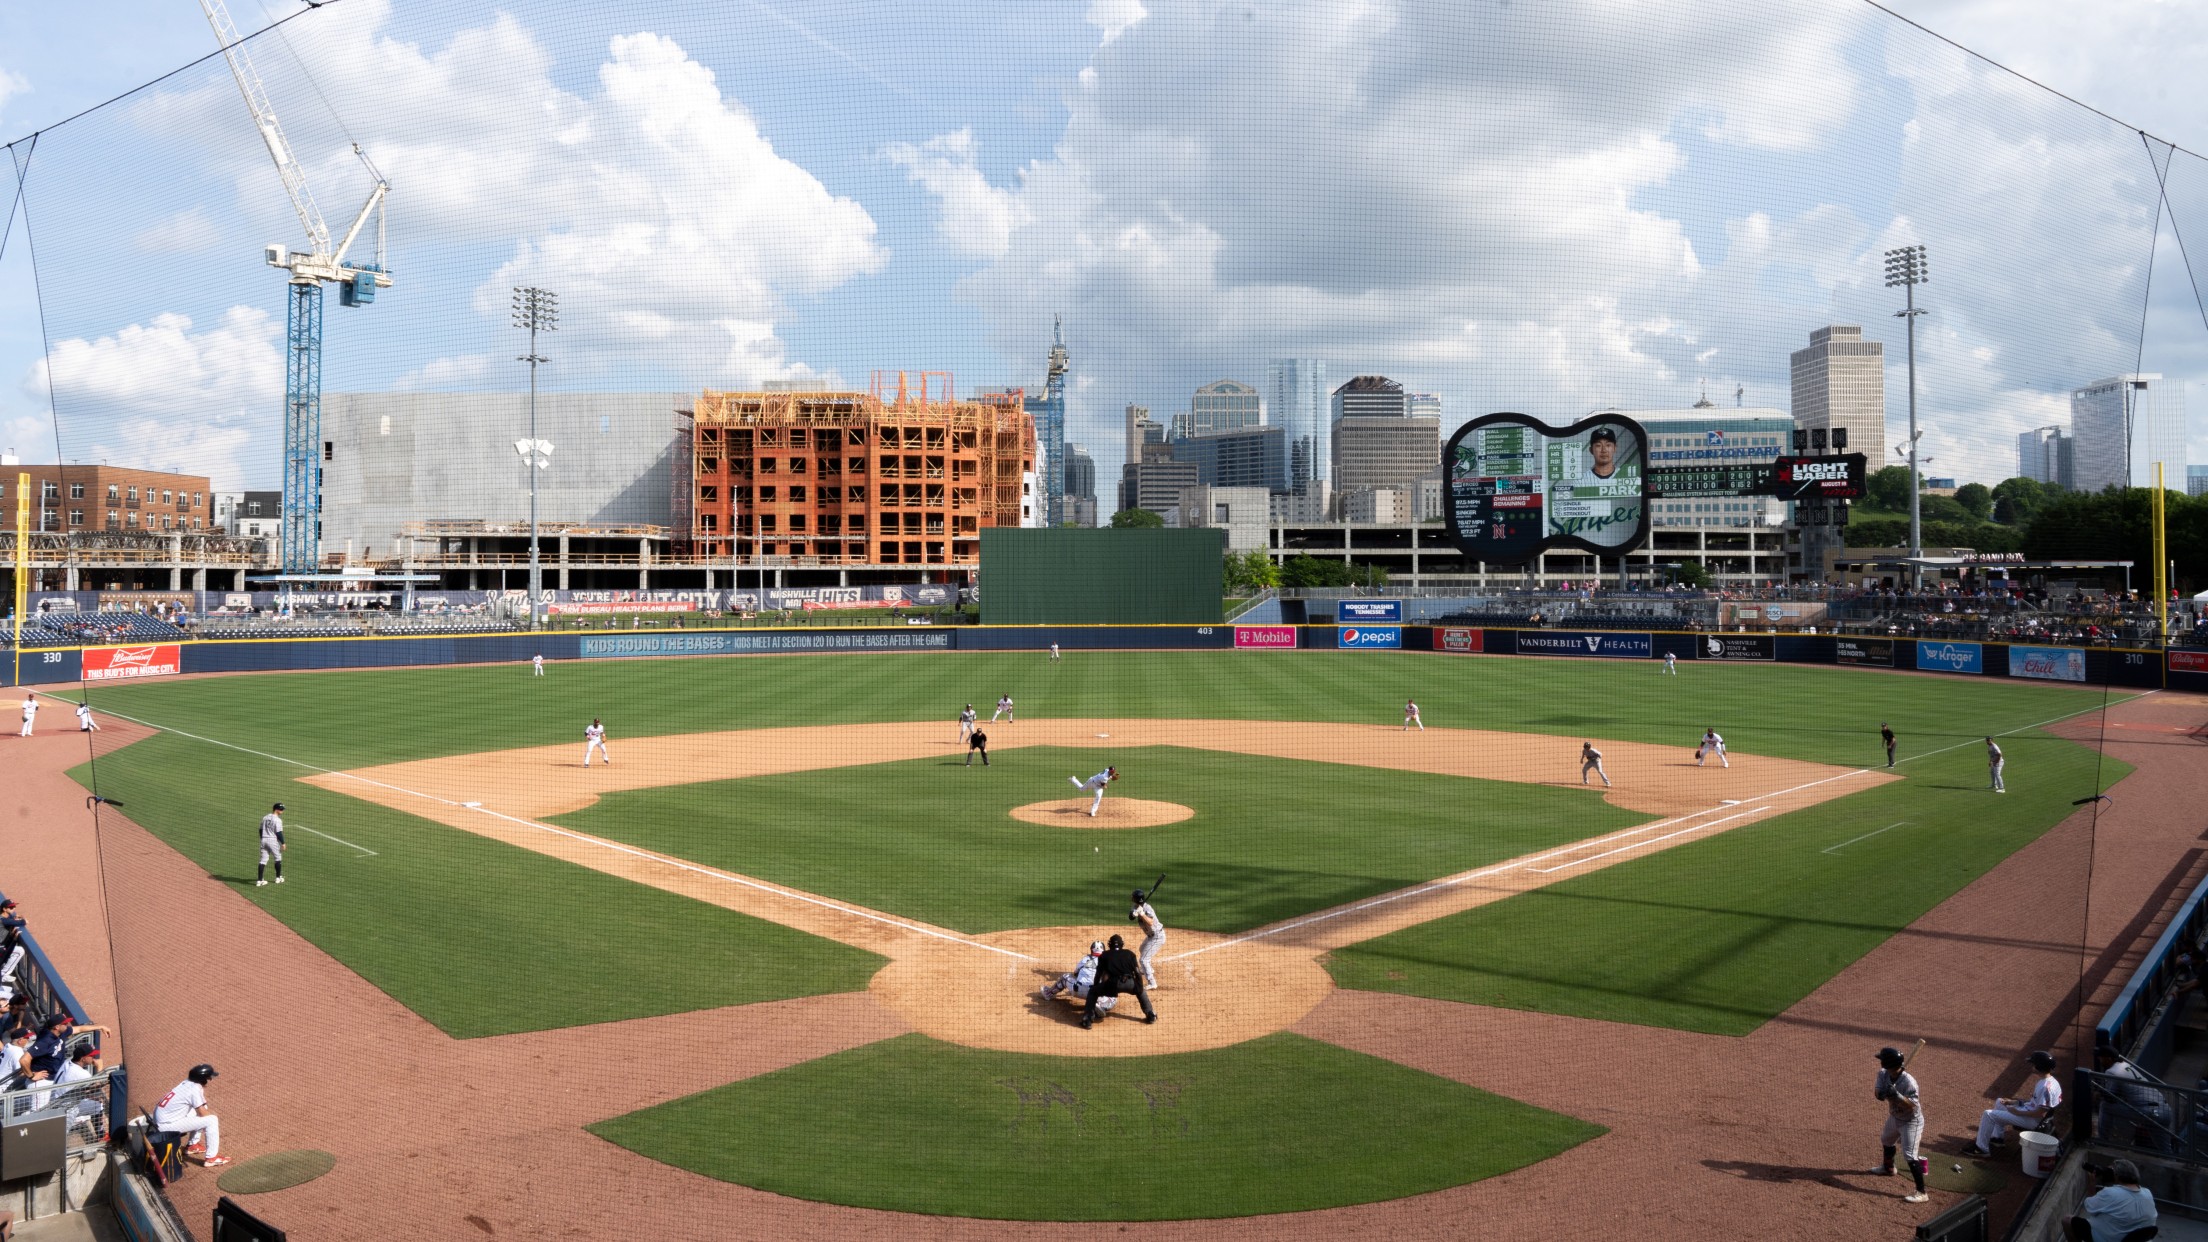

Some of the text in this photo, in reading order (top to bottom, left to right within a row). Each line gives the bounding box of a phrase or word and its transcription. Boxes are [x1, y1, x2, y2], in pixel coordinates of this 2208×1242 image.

[1650, 446, 1783, 460] FIRST HORIZON PARK
[1628, 466, 1636, 477] 11
[1793, 463, 1848, 472] LIGHT
[1599, 486, 1637, 496] PARK
[1492, 524, 1506, 539] N
[1980, 553, 2004, 562] BAND
[2006, 552, 2025, 562] BOX
[2136, 620, 2156, 628] HIVE
[1252, 631, 1291, 642] Mobile
[1362, 632, 1395, 643] pepsi
[586, 639, 616, 653] KIDS
[617, 638, 660, 652] ROUND
[663, 637, 684, 651] THE
[687, 636, 724, 650] BASES
[734, 637, 751, 648] KIDS
[752, 637, 770, 648] MEET
[772, 636, 780, 648] AT
[782, 636, 812, 647] SECTION
[813, 636, 825, 647] 120
[826, 635, 834, 647] TO
[836, 635, 851, 647] RUN
[852, 635, 865, 646] THE
[866, 635, 888, 646] BASES
[890, 634, 911, 646] AFTER
[912, 634, 924, 646] THE
[926, 634, 948, 646] GAME!
[1520, 638, 1582, 648] VANDERBILT
[1604, 641, 1648, 650] HEALTH
[43, 653, 61, 663] 330
[114, 652, 151, 662] Budweiser
[1939, 645, 1973, 669] Kroger
[2125, 654, 2143, 664] 310
[2172, 654, 2194, 665] Bally
[87, 664, 175, 679] THIS BUD'S FOR MUSIC CITY.
[2025, 660, 2055, 673] Chill
